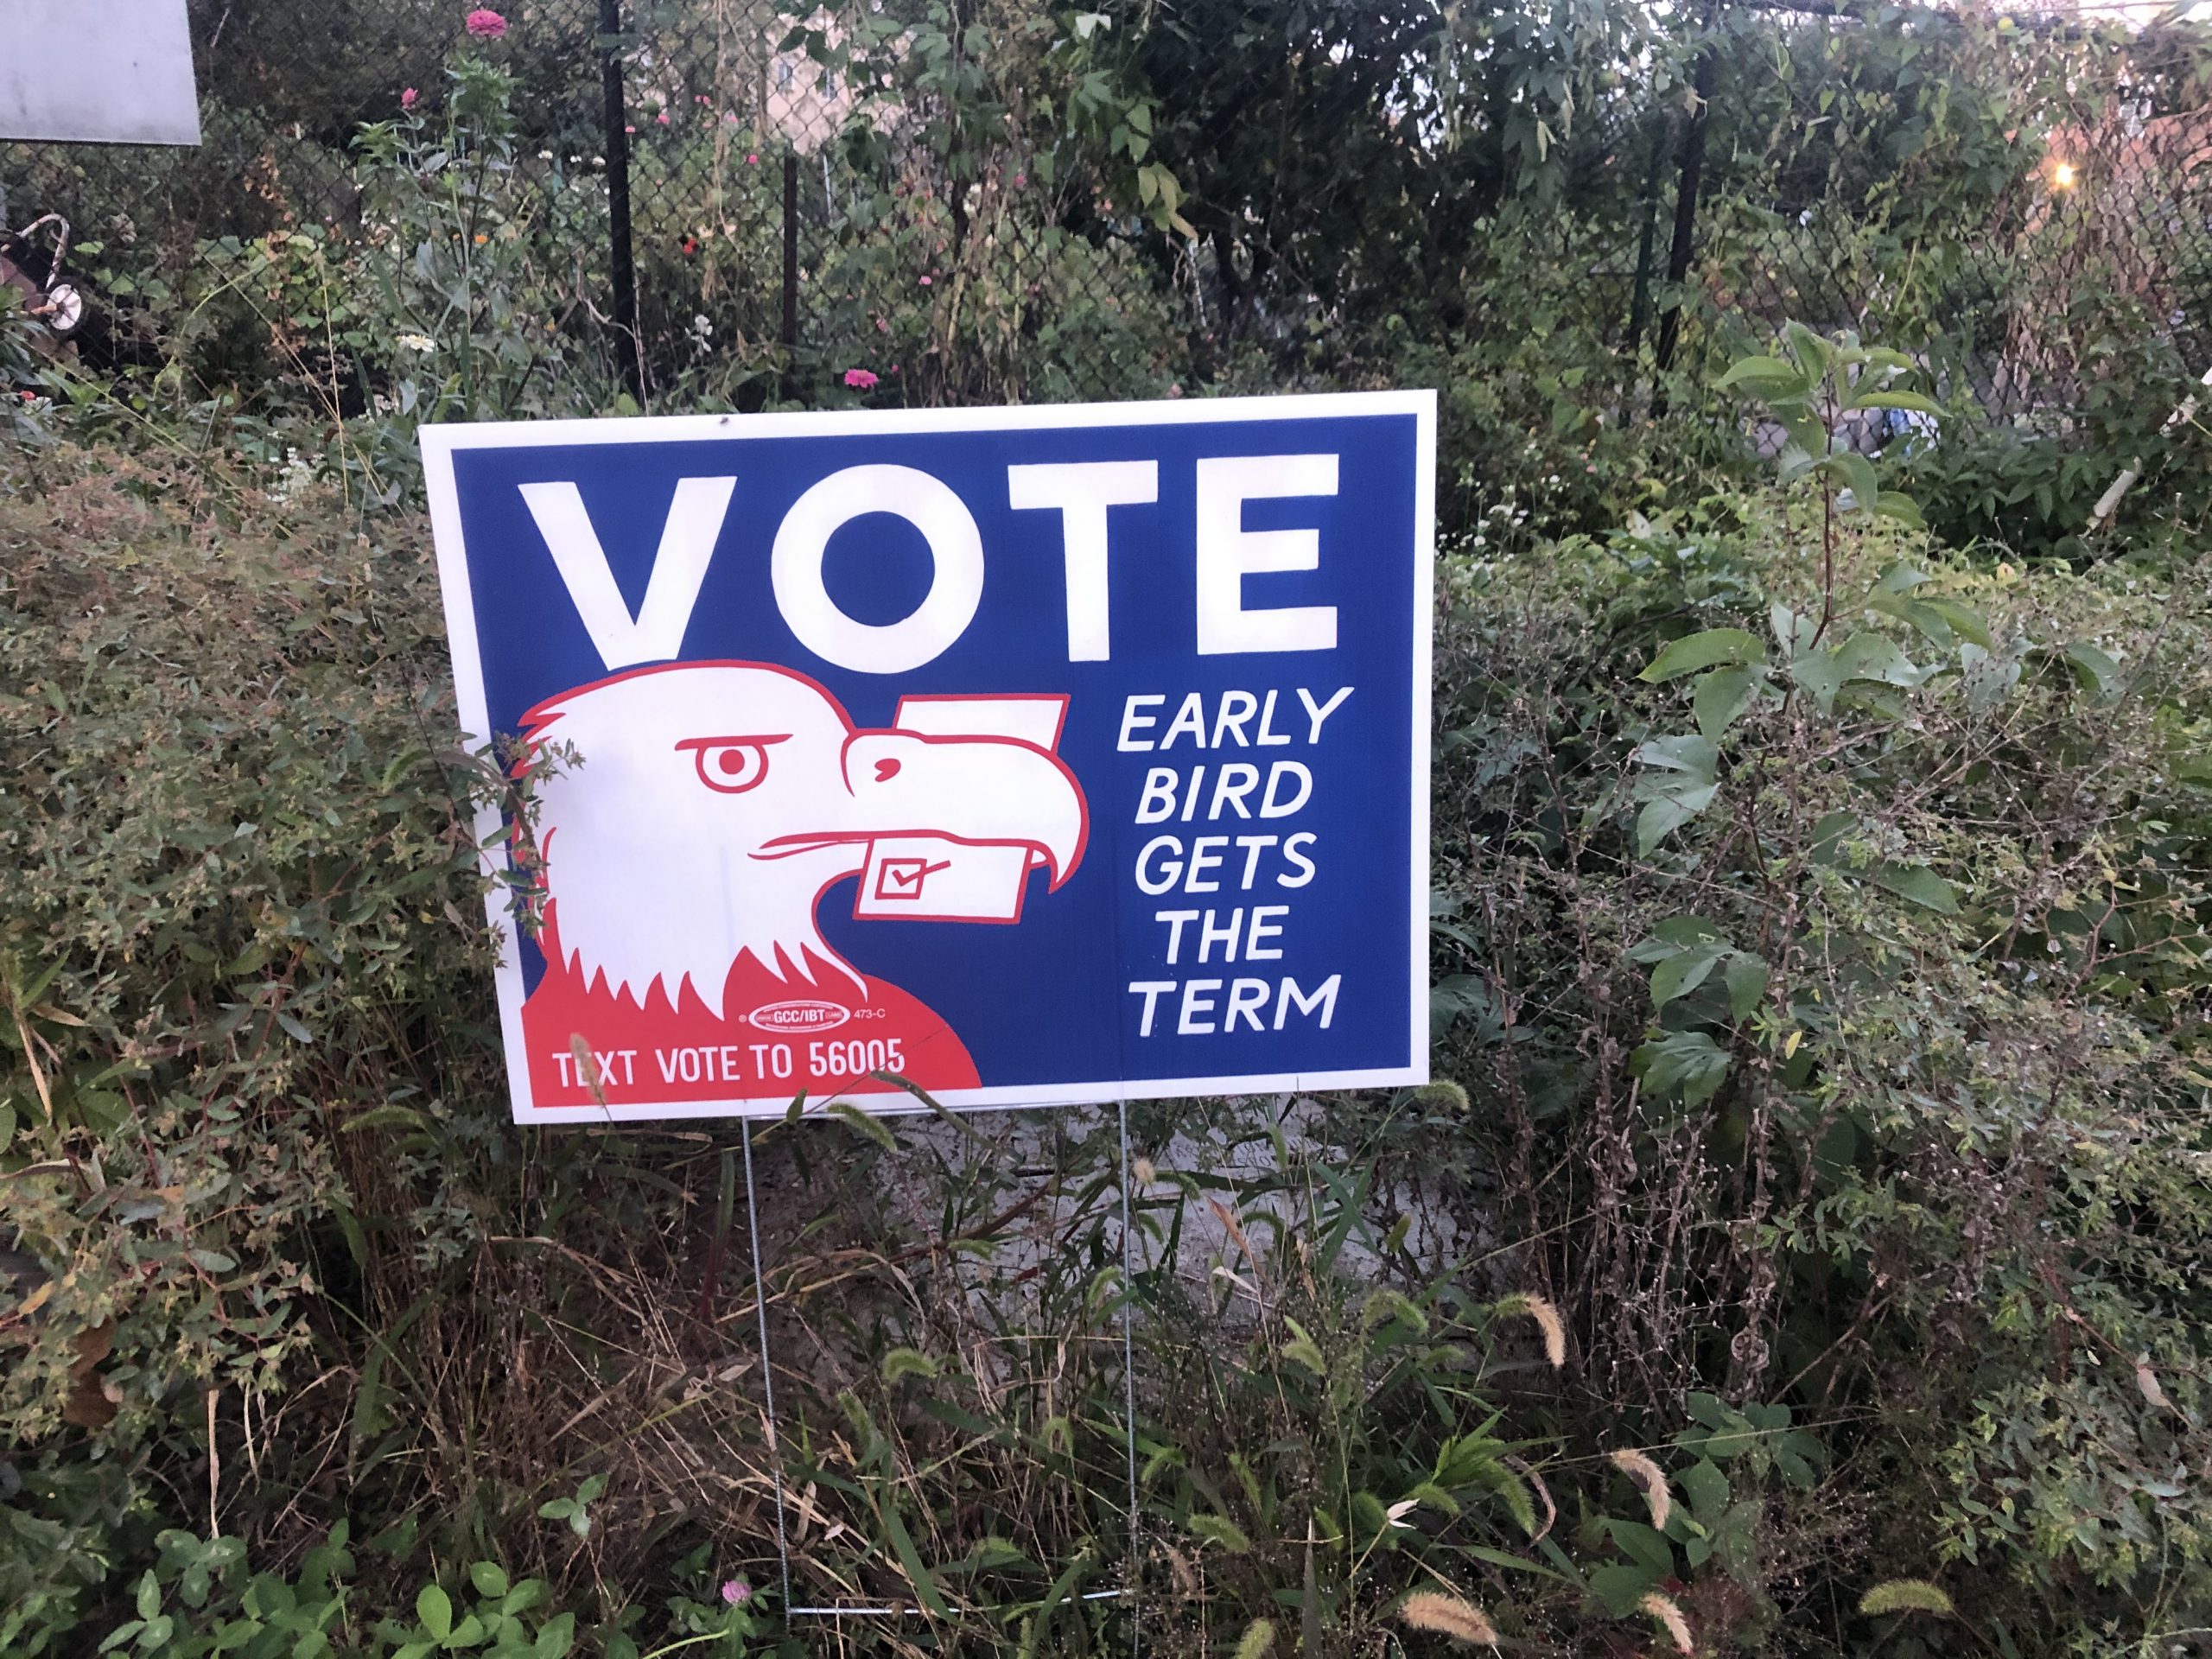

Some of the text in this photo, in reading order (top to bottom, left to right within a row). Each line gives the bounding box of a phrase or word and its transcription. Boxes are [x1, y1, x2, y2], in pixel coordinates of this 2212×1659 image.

[518, 453, 1340, 674] VOTE
[1116, 686, 1355, 753] EARLY
[1135, 760, 1313, 824] BIRD
[1135, 831, 1318, 896] GETS
[1154, 905, 1290, 965] THE
[773, 1008, 826, 1024] GCC/IBT
[853, 1007, 887, 1020] 473-C
[1128, 974, 1342, 1038] TERM
[655, 1046, 741, 1083] VOTE
[748, 1044, 792, 1079] TO
[809, 1039, 906, 1077] 56005
